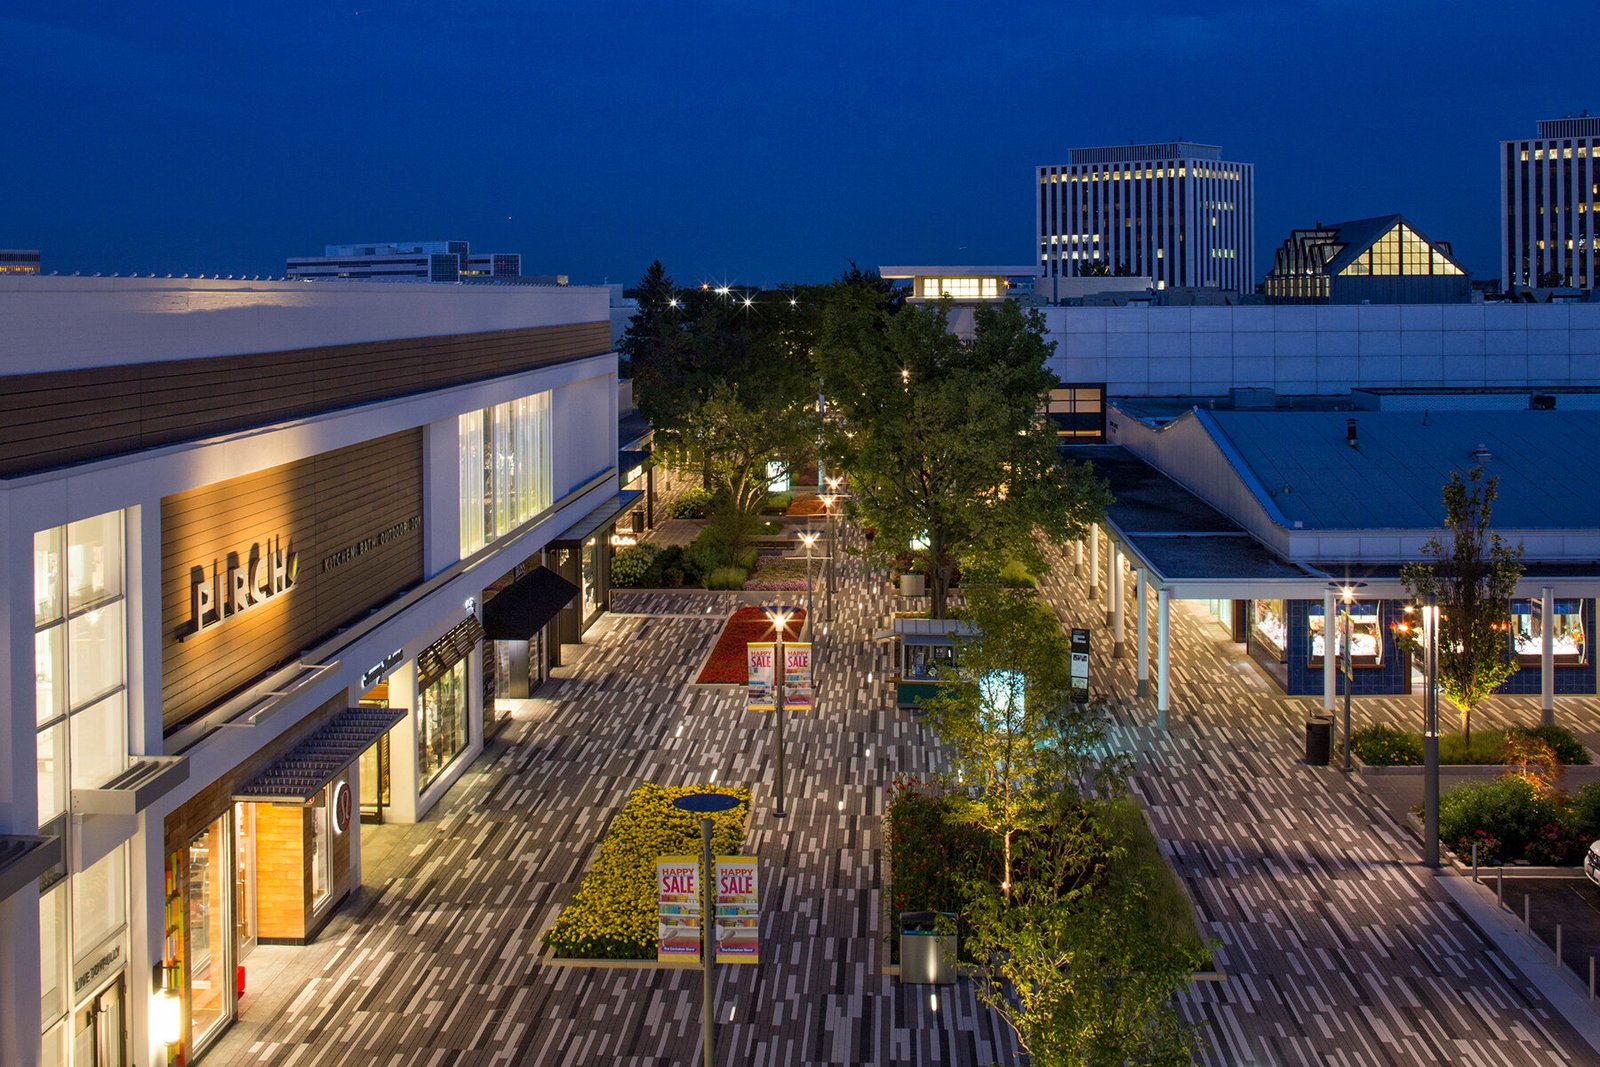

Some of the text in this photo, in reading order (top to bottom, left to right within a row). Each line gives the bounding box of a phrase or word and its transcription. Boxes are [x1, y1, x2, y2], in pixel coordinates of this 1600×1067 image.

[197, 549, 288, 633] PIRCH
[751, 656, 771, 667] SALE
[787, 656, 808, 667] SALE
[662, 876, 694, 893] SALE
[720, 877, 753, 894] SALE
